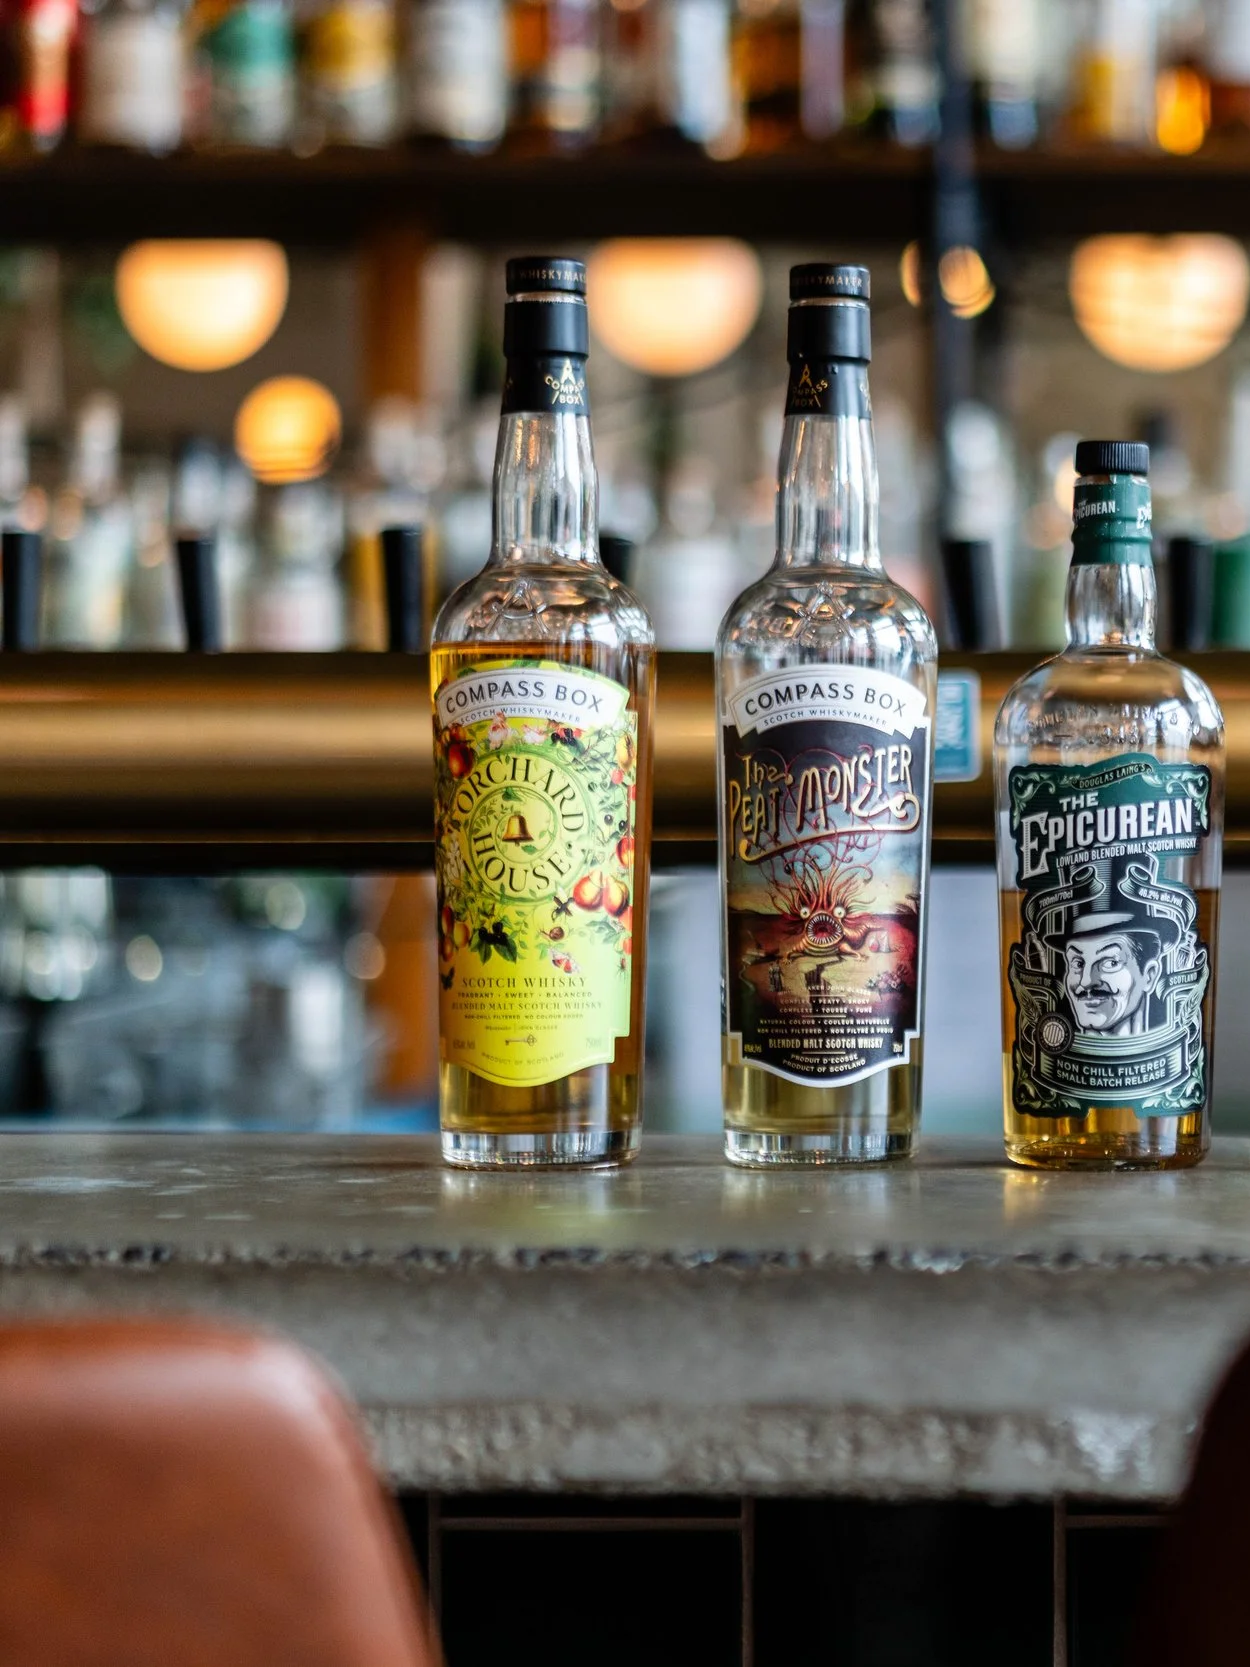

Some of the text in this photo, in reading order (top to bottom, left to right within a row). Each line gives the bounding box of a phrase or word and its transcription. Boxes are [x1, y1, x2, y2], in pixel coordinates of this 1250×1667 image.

[519, 268, 586, 283] WHISKYMAK
[559, 395, 580, 406] BOX
[1074, 500, 1116, 521] PICUREAN
[446, 680, 603, 714] COMPASS BOX
[745, 683, 907, 717] COMPASS BOX
[461, 706, 580, 725] SCOTCH WHISKYMAKER
[764, 709, 887, 727] SCOTCH WHISKYMAKER
[1079, 763, 1147, 789] DOUGLAS LAING'S
[456, 757, 585, 832] ORCHARD
[1059, 791, 1099, 812] THE
[1020, 798, 1193, 880] EPICUREAN
[473, 832, 572, 893] HOUSE
[1056, 837, 1197, 869] LOWLAND BLENDED MALT SCOTCH WHISKY
[462, 977, 587, 988] SCOTCH WHISKY
[1169, 972, 1198, 986] SCOTLAND
[489, 1002, 514, 1010] MALT
[518, 1002, 560, 1010] SCOTCH
[565, 1001, 602, 1010] WHISKY
[769, 1038, 801, 1049] BLENDED
[803, 1038, 824, 1049] MALT
[825, 1038, 856, 1049] SCOTCH
[857, 1037, 884, 1049] WHISKY
[783, 1060, 815, 1072] PRODUCT
[829, 1059, 867, 1073] SCOTLAND
[791, 1054, 820, 1064] PRODUIT
[1057, 1058, 1167, 1078] NON CHILL FILTERED
[1056, 1069, 1166, 1088] SMALL BATCH RELEASE
